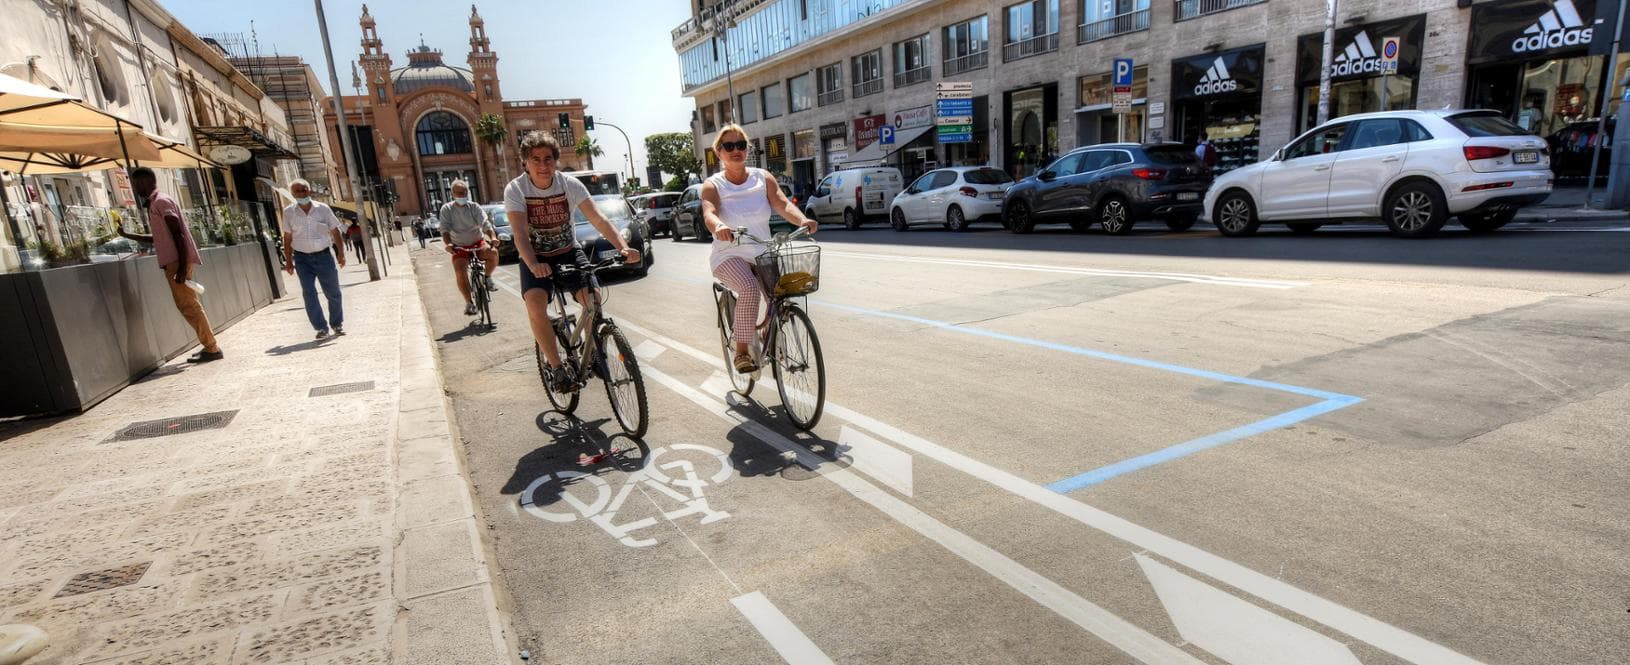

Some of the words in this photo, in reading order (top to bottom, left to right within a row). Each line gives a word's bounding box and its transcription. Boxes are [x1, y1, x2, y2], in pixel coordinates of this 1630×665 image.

[1511, 28, 1593, 52] adidas
[1117, 61, 1129, 83] P
[1194, 79, 1237, 95] adidas
[882, 128, 891, 142] P
